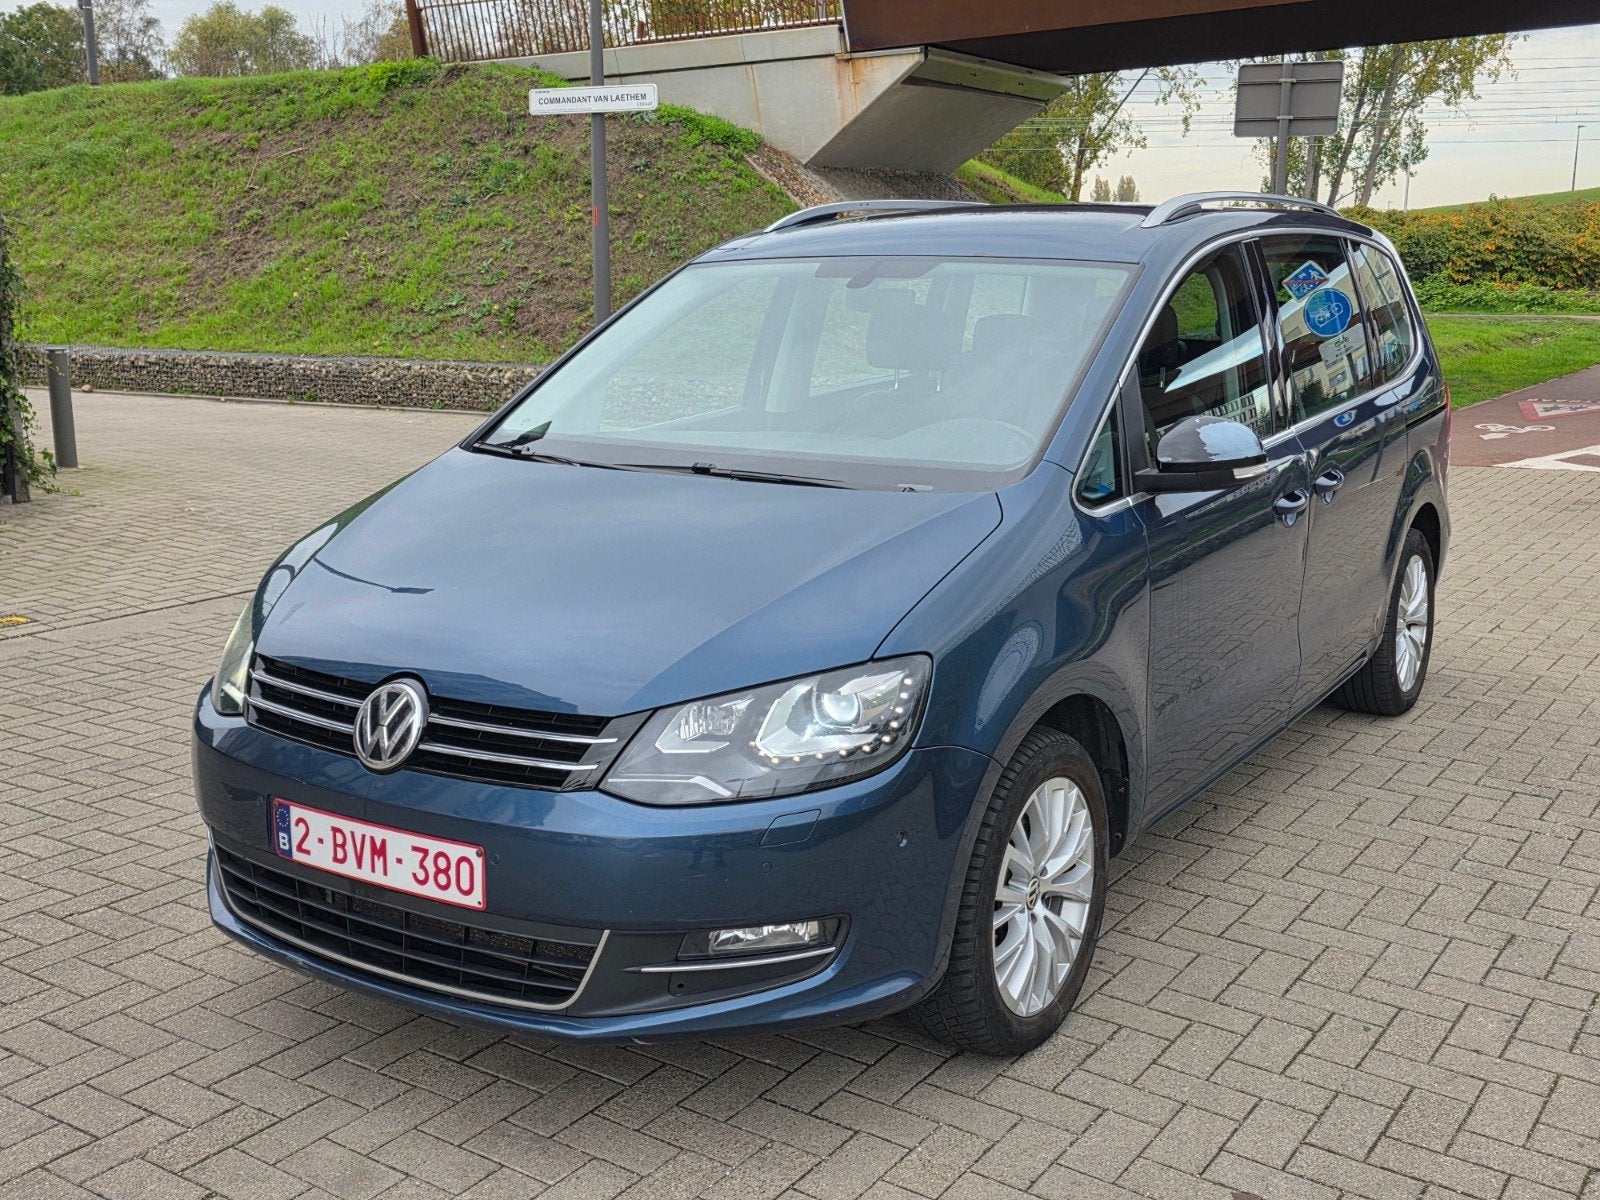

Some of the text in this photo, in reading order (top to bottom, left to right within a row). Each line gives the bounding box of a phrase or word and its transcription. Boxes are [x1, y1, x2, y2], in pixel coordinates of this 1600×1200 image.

[538, 93, 647, 105] COMMANDANT VAN LAETHEM
[357, 684, 421, 768] VW
[278, 831, 290, 851] B
[294, 816, 475, 897] 2-BVM-380
